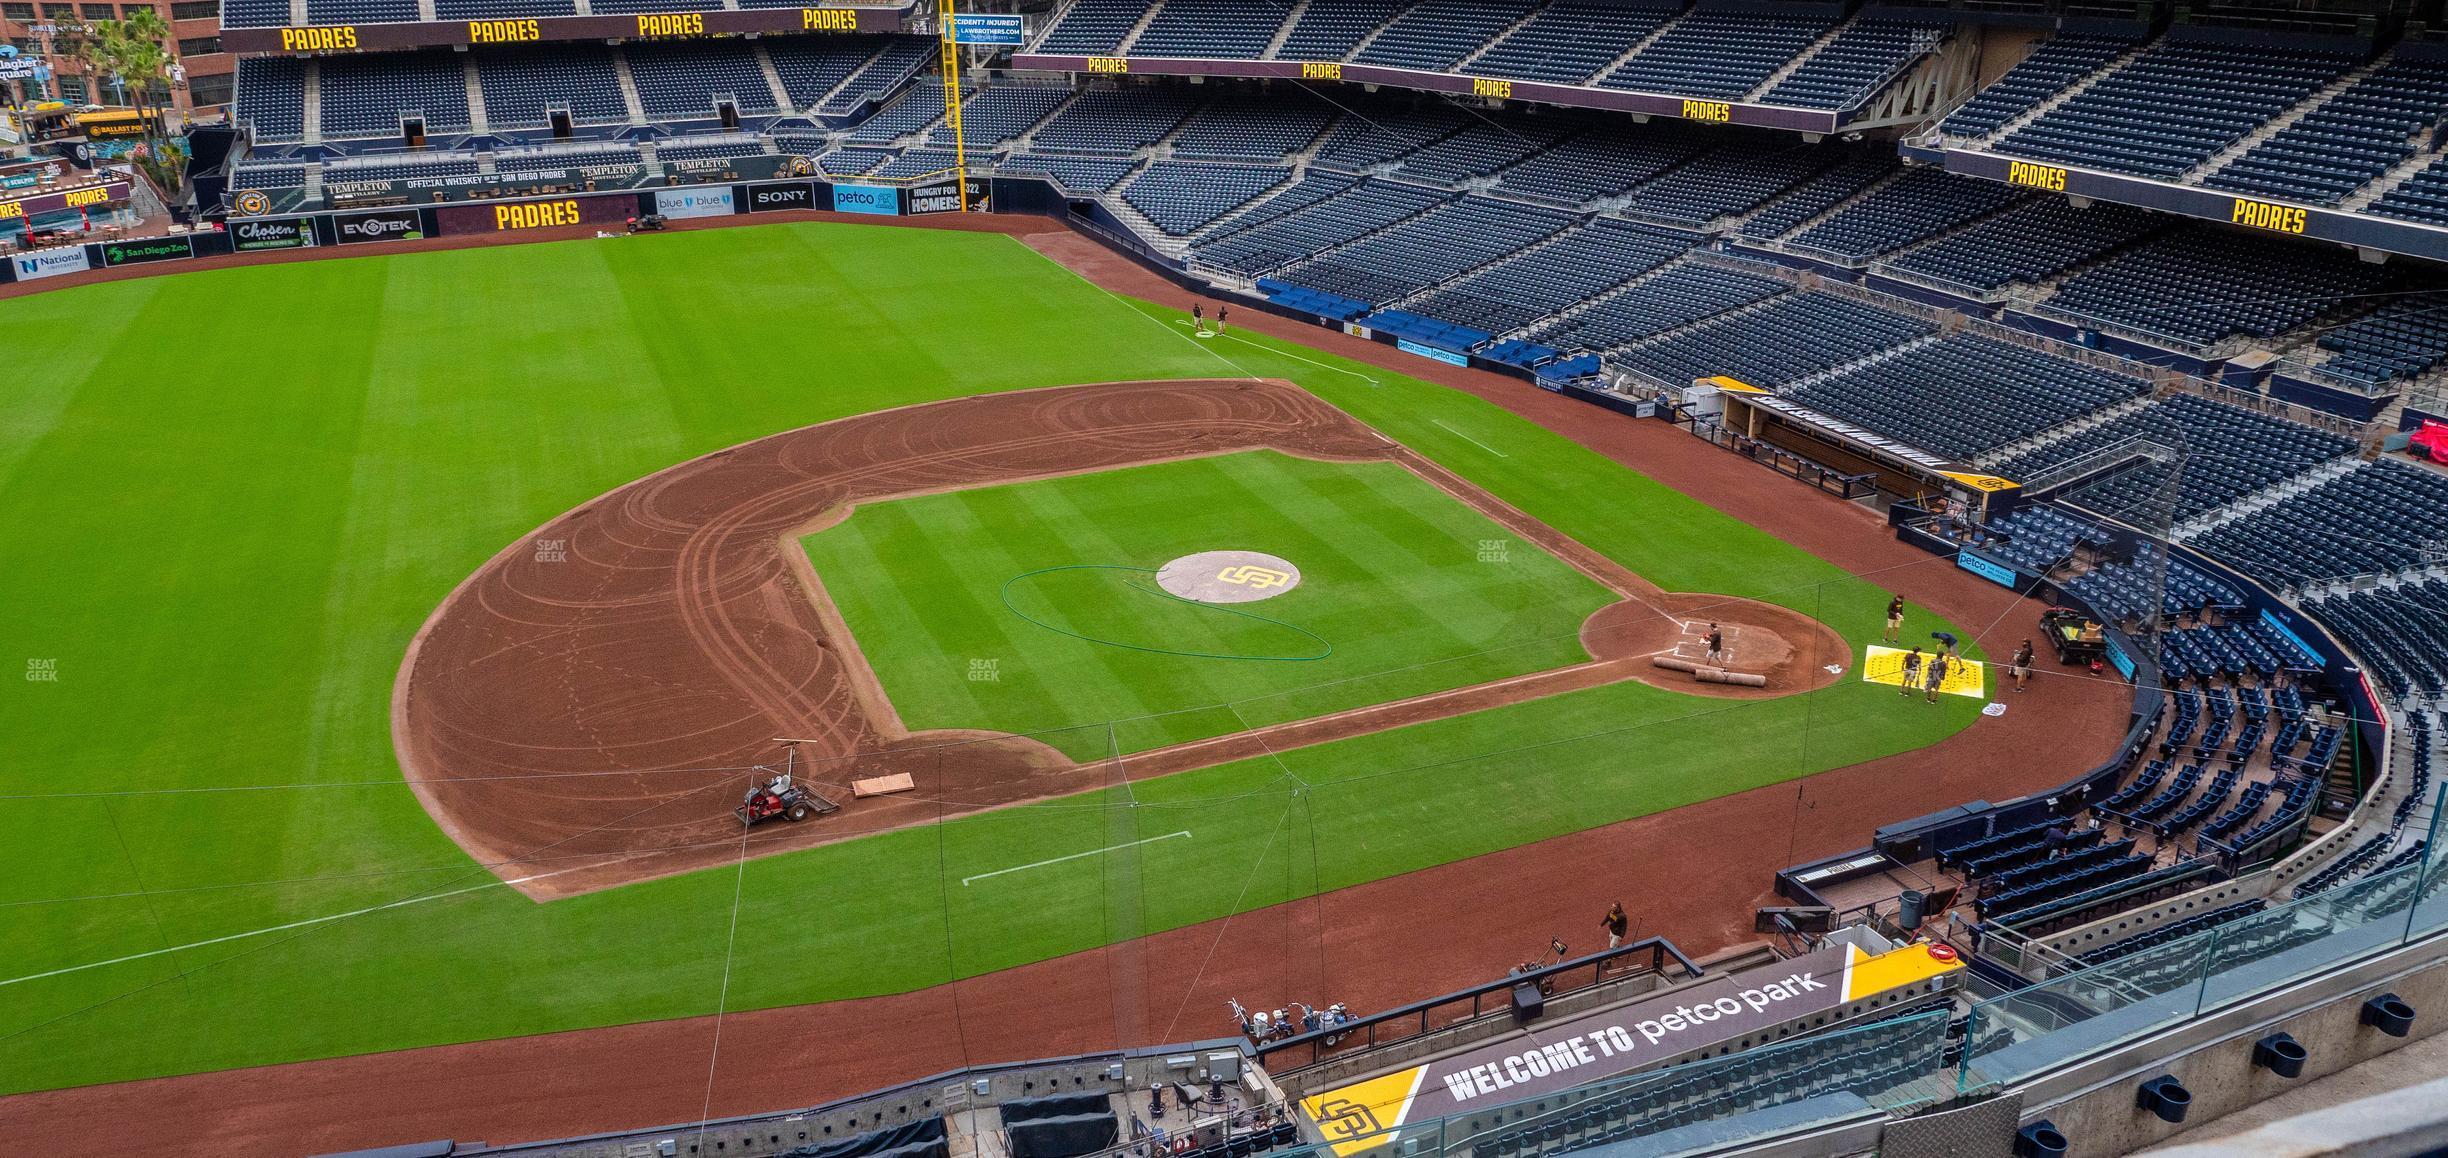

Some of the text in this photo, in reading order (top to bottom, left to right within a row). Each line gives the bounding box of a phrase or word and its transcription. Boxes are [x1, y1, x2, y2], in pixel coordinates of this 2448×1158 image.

[638, 13, 703, 36] PADRES
[803, 9, 857, 30] PADRES
[282, 26, 357, 50] PADRES
[469, 20, 539, 42] PADRES
[1088, 58, 1127, 73] PADRES
[1303, 63, 1341, 80] PADRES
[1474, 78, 1511, 98] PADRES
[1682, 99, 1729, 122] PADRES
[100, 124, 151, 133] BALLAST POIT
[580, 165, 638, 178] TEMPLETON
[674, 158, 730, 171] TEMPLETON
[407, 179, 444, 189] OFFICIAL
[445, 176, 482, 186] WHISKEY
[501, 172, 517, 182] SAN
[518, 171, 538, 181] DIEGO
[539, 170, 567, 180] PADRES
[2009, 161, 2066, 191] PADRES
[327, 182, 392, 194] TEMPLETON
[914, 186, 956, 197] HUNGRY FOR
[966, 184, 980, 194] 322
[65, 188, 108, 208] PADRES
[659, 196, 720, 208] blue blue
[758, 190, 806, 203] SONY
[837, 191, 874, 206] petco
[912, 196, 961, 212] HOMERS
[0, 202, 23, 218] RES
[495, 200, 579, 229] PADRES
[2232, 198, 2306, 234] PADRES
[239, 223, 295, 238] Chosen
[344, 219, 412, 236] EVOTEK
[40, 252, 82, 265] National
[126, 244, 188, 257] San Diego Zoo
[1398, 339, 1414, 351] petco
[1433, 350, 1450, 361] petco
[1960, 554, 1986, 571] petco
[1443, 972, 1827, 1102] WELCOME TO petco park
